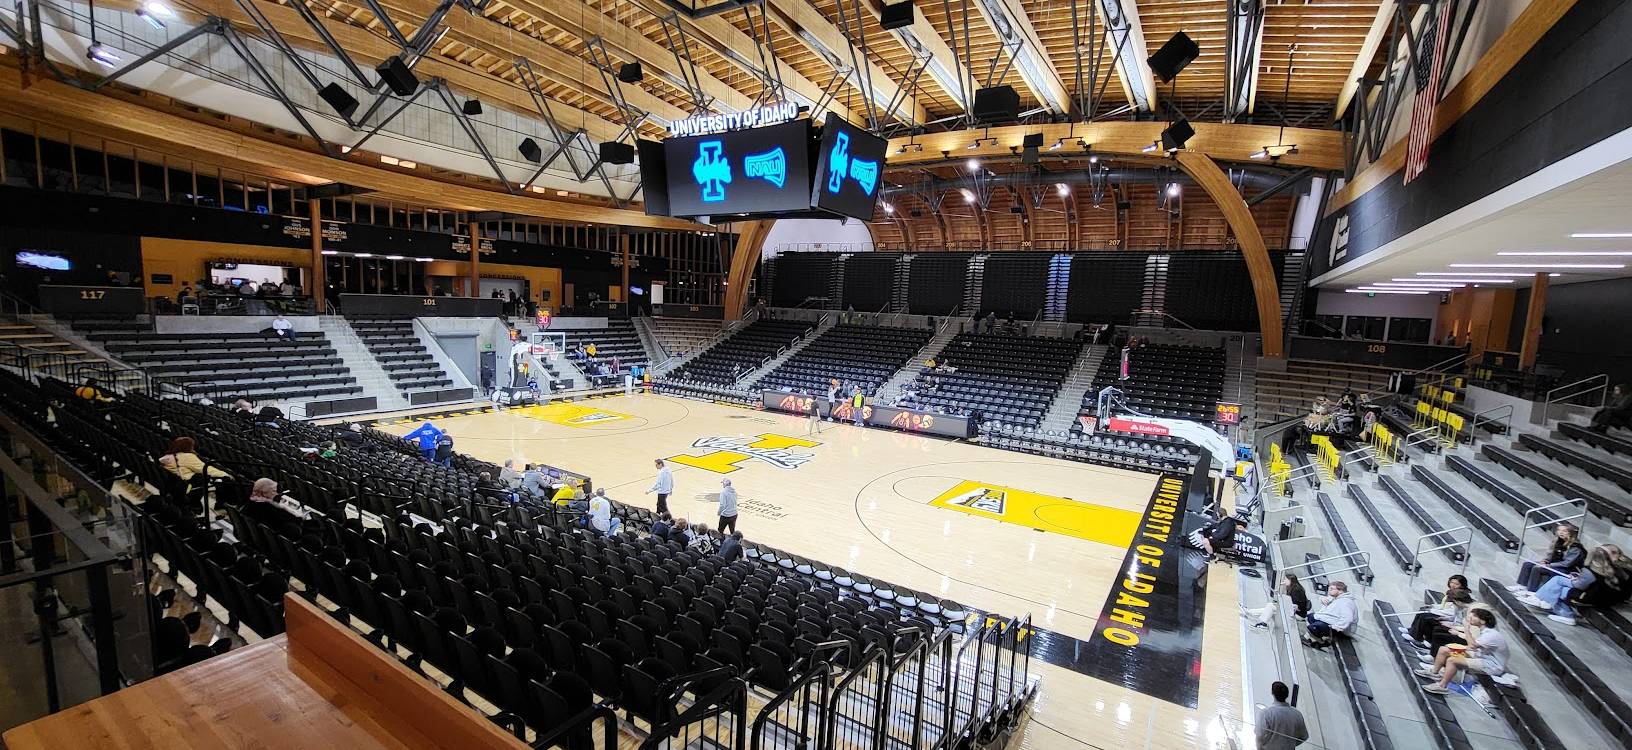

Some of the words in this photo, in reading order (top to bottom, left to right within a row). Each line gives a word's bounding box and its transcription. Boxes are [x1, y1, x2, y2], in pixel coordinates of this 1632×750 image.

[671, 112, 741, 135] UNIVERSITY
[743, 109, 759, 126] OF
[760, 102, 798, 124] IDAHO
[750, 159, 781, 177] NAU
[81, 290, 105, 300] 117
[1367, 344, 1386, 353] 108
[1222, 413, 1234, 421] 30
[1143, 477, 1184, 543] UNIVERSITY
[1234, 533, 1252, 544] aho
[1235, 542, 1262, 555] ntral
[1137, 545, 1164, 568] OF
[1103, 573, 1157, 647] IDAHO
